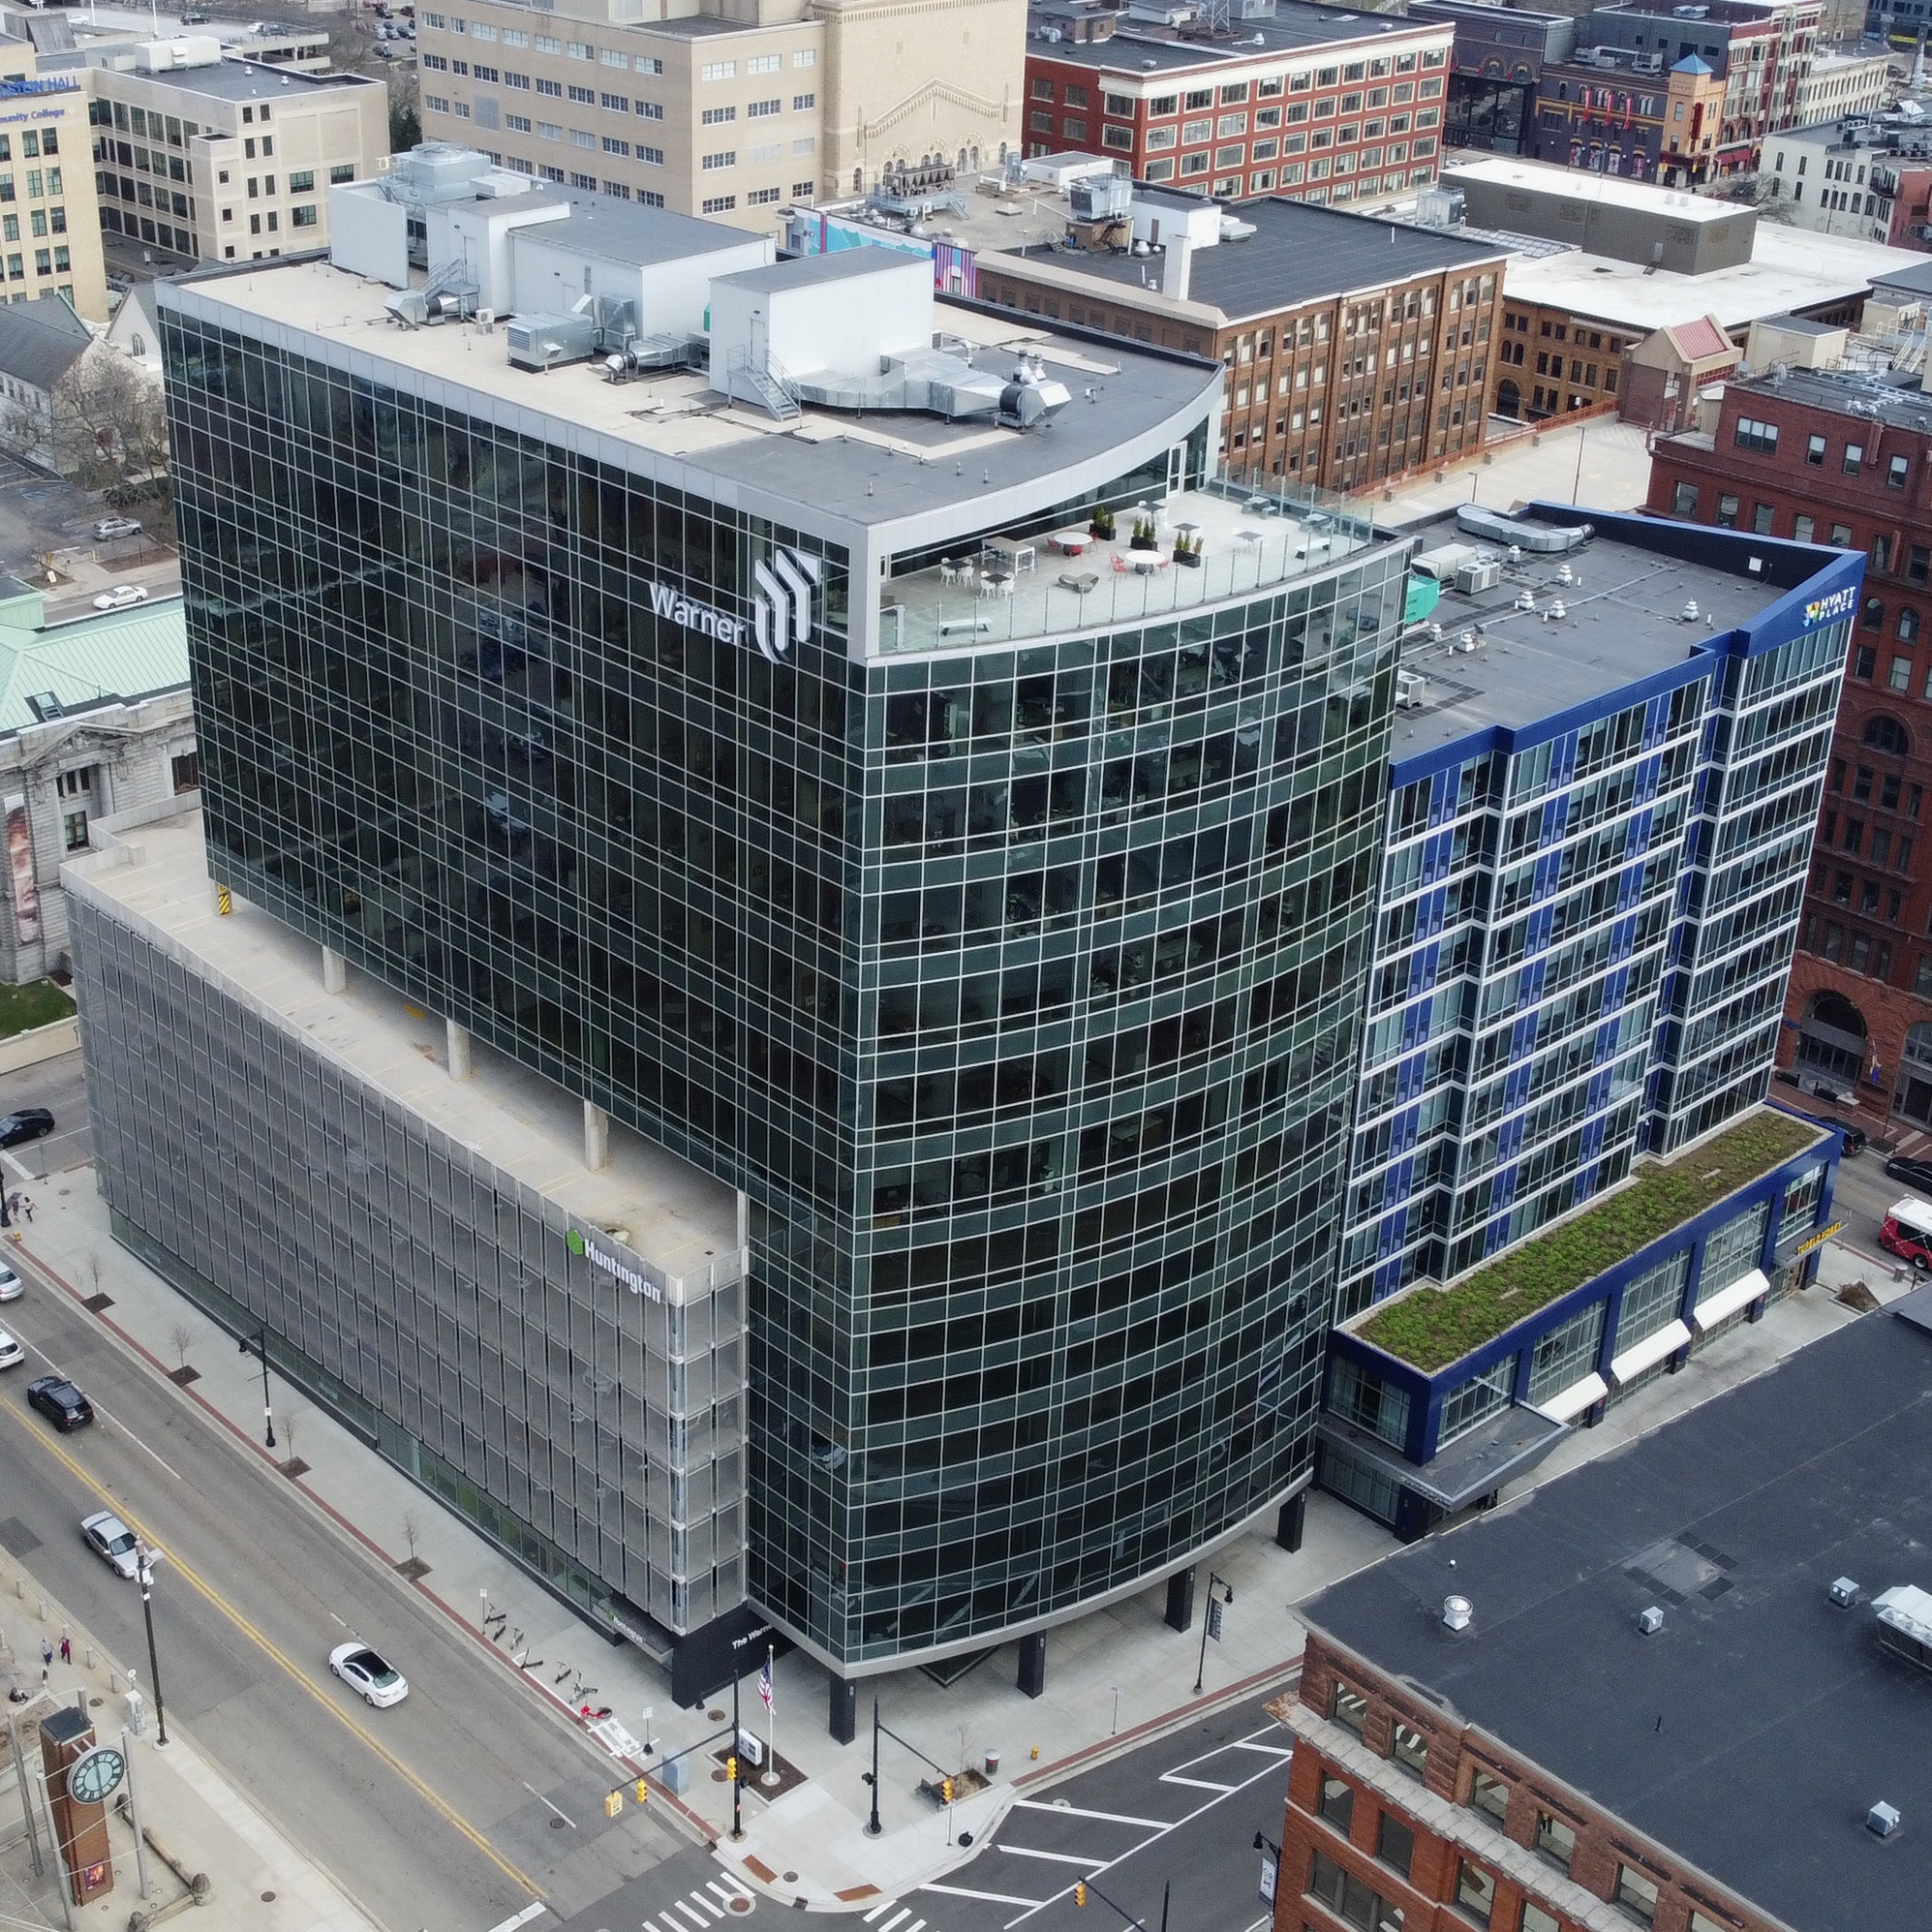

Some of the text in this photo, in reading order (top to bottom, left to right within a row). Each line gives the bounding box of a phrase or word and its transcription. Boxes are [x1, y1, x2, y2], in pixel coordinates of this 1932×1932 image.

[47, 76, 78, 91] HALL
[31, 108, 65, 119] College
[1819, 598, 1855, 621] PLACE
[1821, 586, 1856, 611] HYATT
[649, 581, 747, 646] Warner
[584, 1238, 661, 1304] Huntington
[731, 1637, 748, 1650] The
